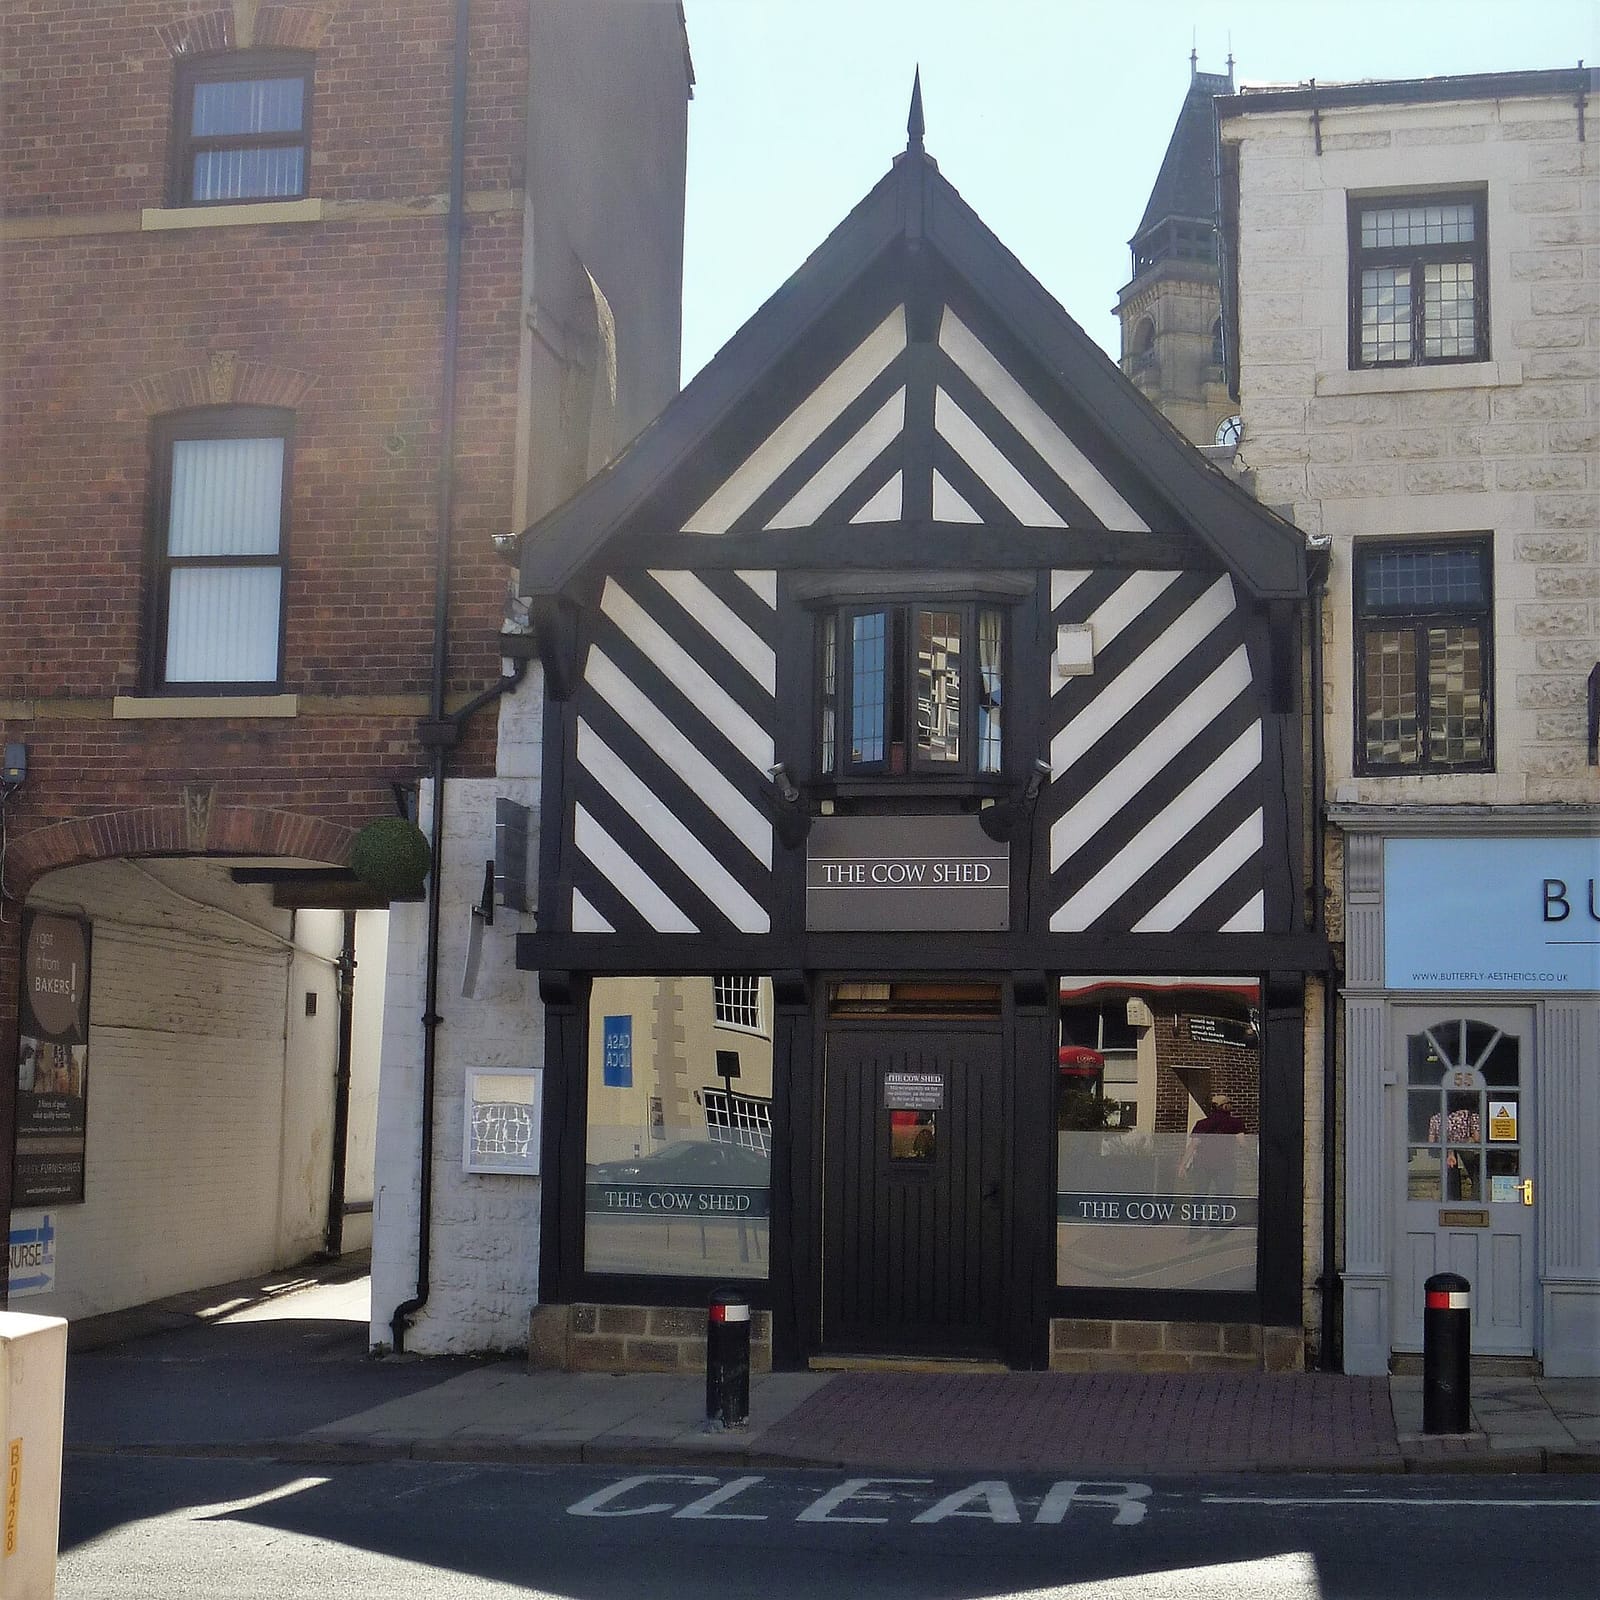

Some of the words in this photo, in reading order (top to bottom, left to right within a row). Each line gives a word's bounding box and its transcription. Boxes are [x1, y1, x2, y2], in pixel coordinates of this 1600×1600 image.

[822, 864, 866, 883] THE
[871, 864, 926, 883] COW
[933, 863, 991, 883] SHED
[888, 1074, 903, 1082] THE
[920, 1075, 941, 1083] SHED
[605, 1191, 643, 1208] THE
[648, 1192, 694, 1210] COW
[698, 1194, 750, 1211] SHED
[1078, 1201, 1120, 1219] THE
[1126, 1202, 1175, 1220] COW
[1181, 1203, 1237, 1222] SHED
[566, 1474, 1154, 1527] CLEAR
